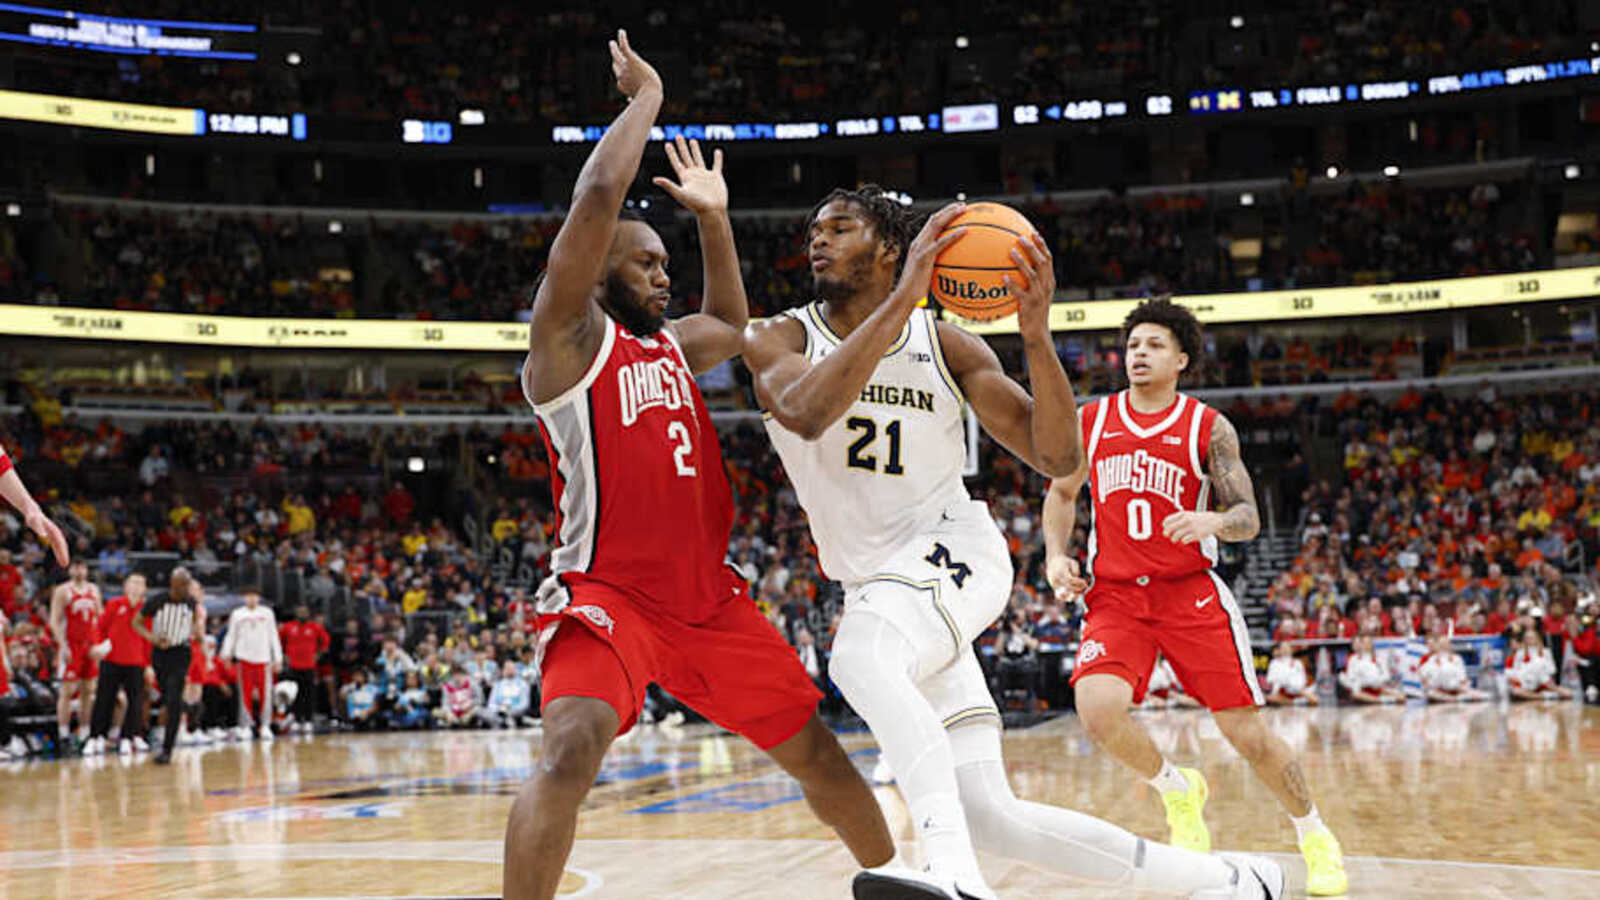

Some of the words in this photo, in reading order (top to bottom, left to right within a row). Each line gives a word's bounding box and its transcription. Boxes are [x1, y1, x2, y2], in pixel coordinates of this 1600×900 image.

[860, 384, 936, 413] HIGAN
[668, 420, 697, 477] 2
[846, 414, 905, 476] 21
[1127, 498, 1153, 541] 0
[923, 540, 973, 591] M
